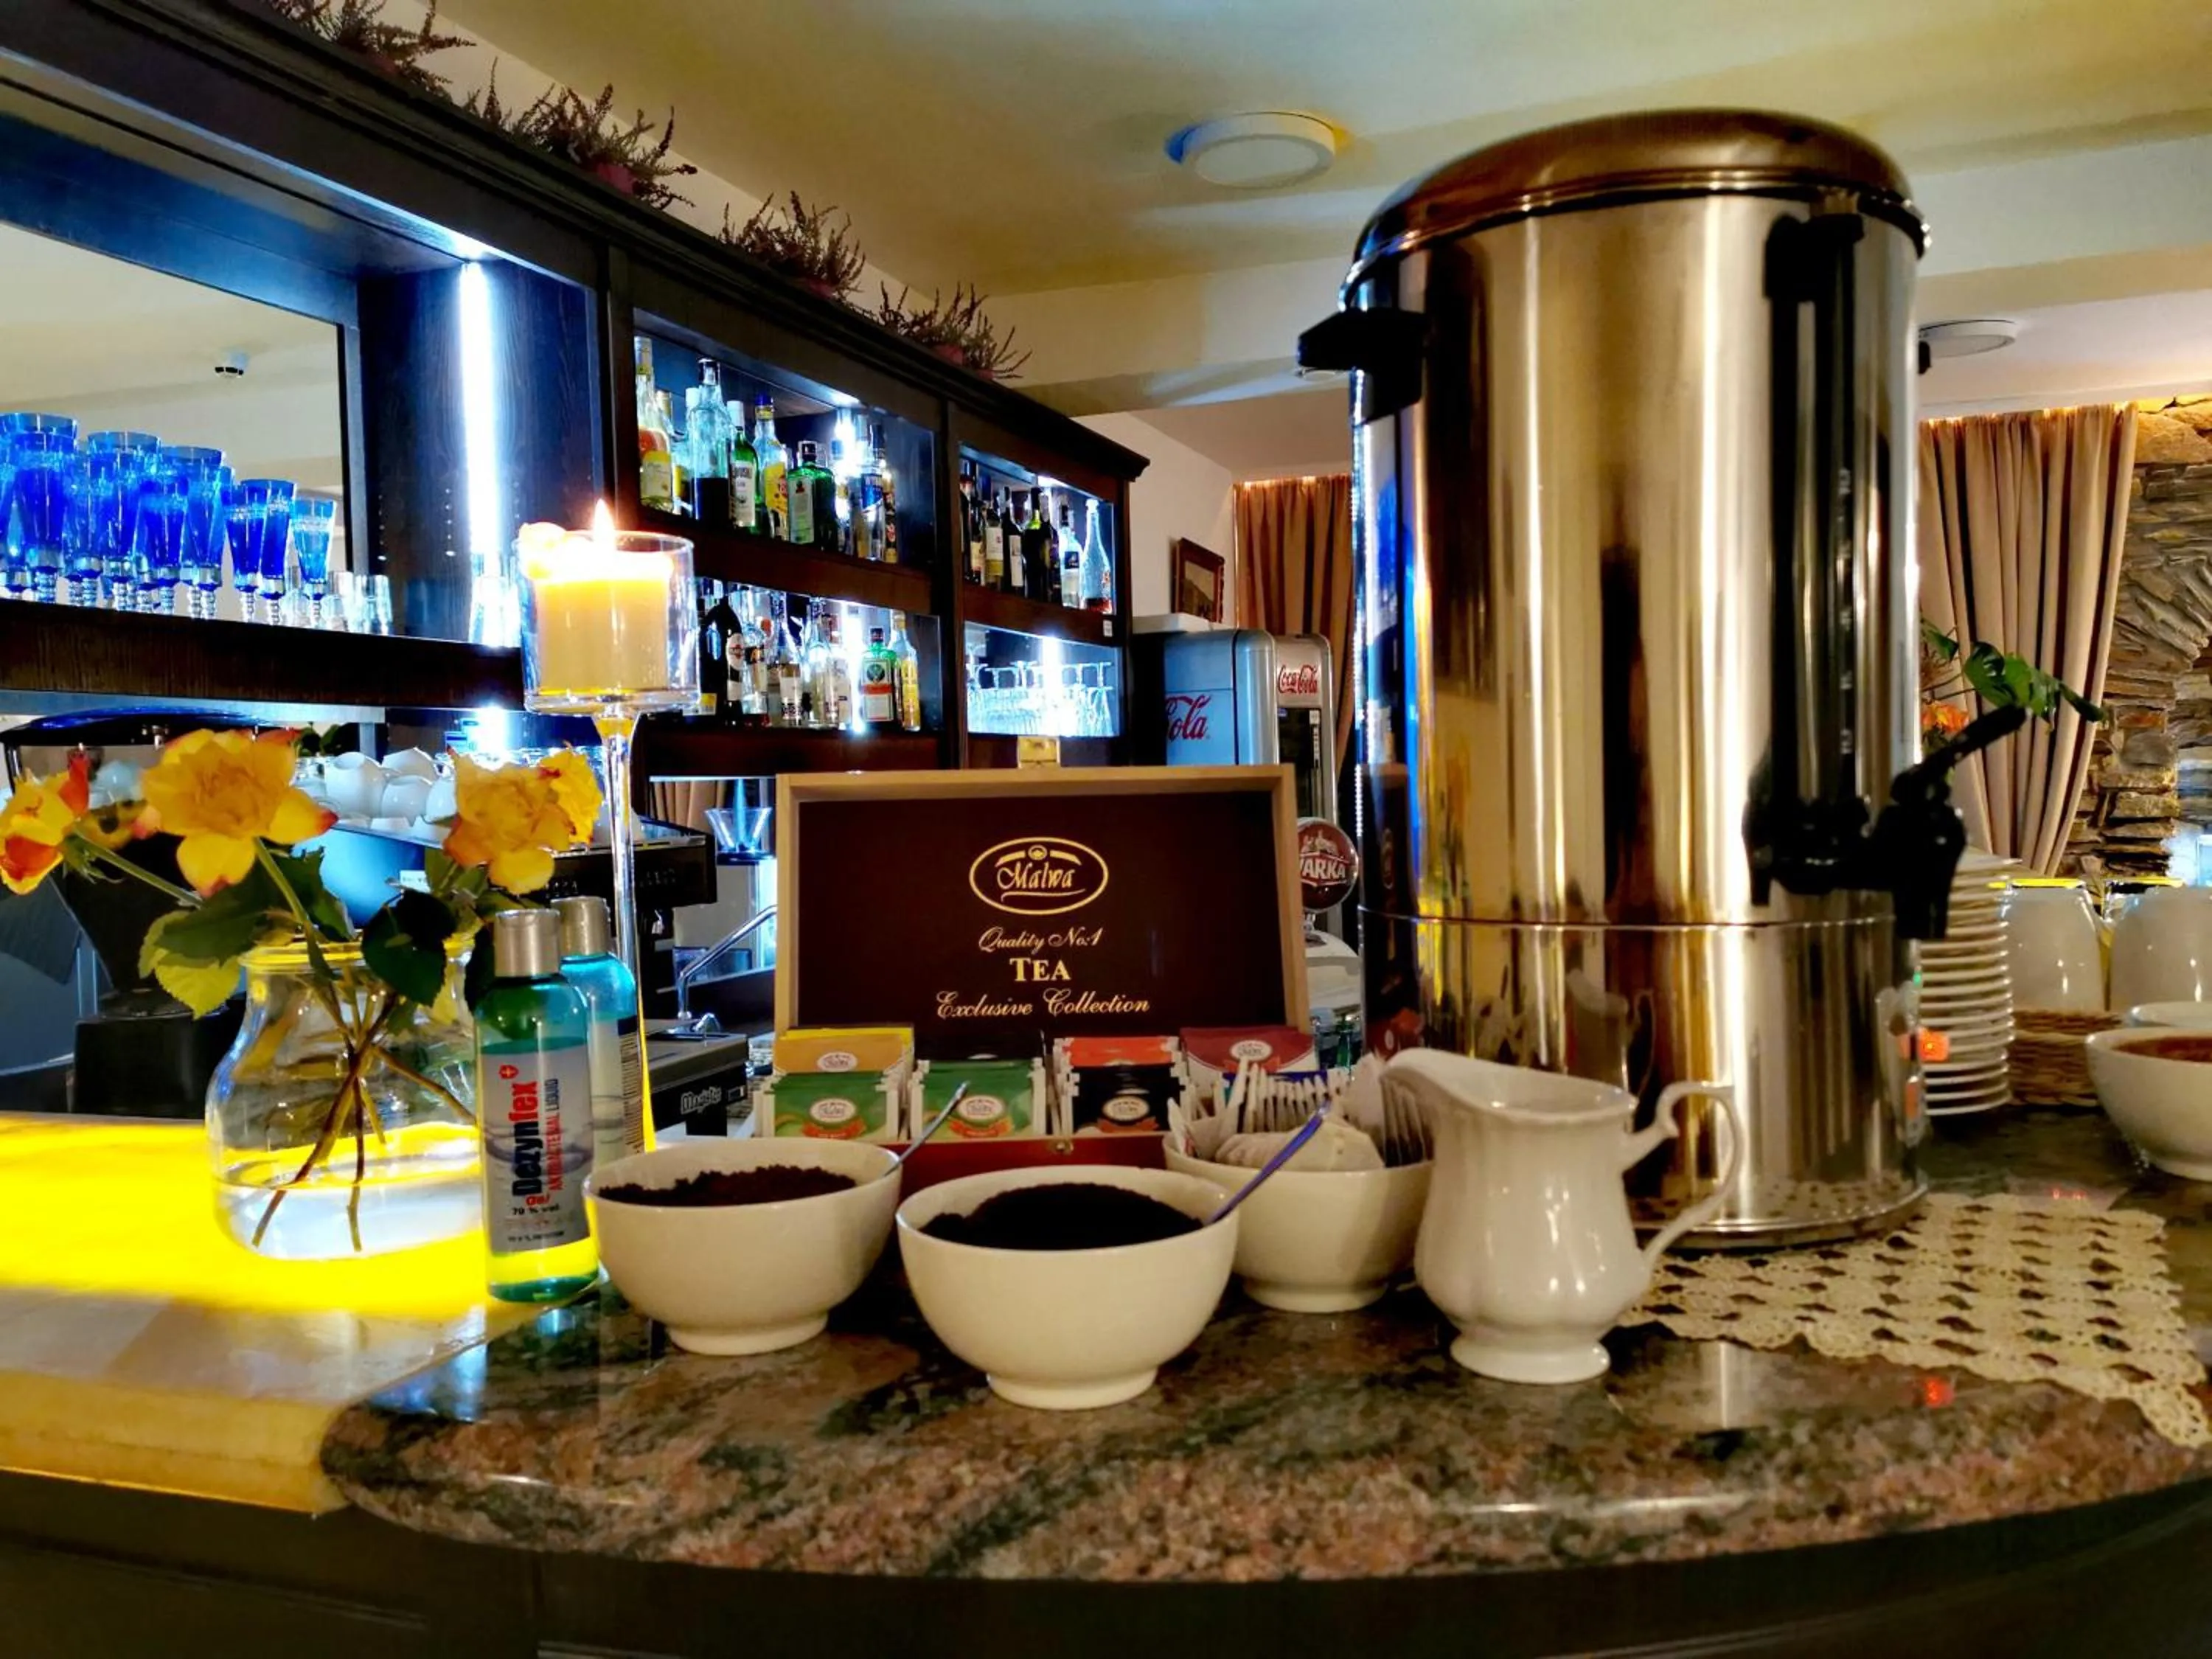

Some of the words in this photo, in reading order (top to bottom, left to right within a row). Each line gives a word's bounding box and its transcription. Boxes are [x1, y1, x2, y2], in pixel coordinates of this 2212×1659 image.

[997, 861, 1076, 889] Malwa
[1299, 858, 1346, 880] ARKA
[978, 926, 1045, 955] Quality
[1009, 957, 1071, 982] TEA
[936, 991, 1033, 1020] Exclusive
[1043, 988, 1150, 1016] Collection
